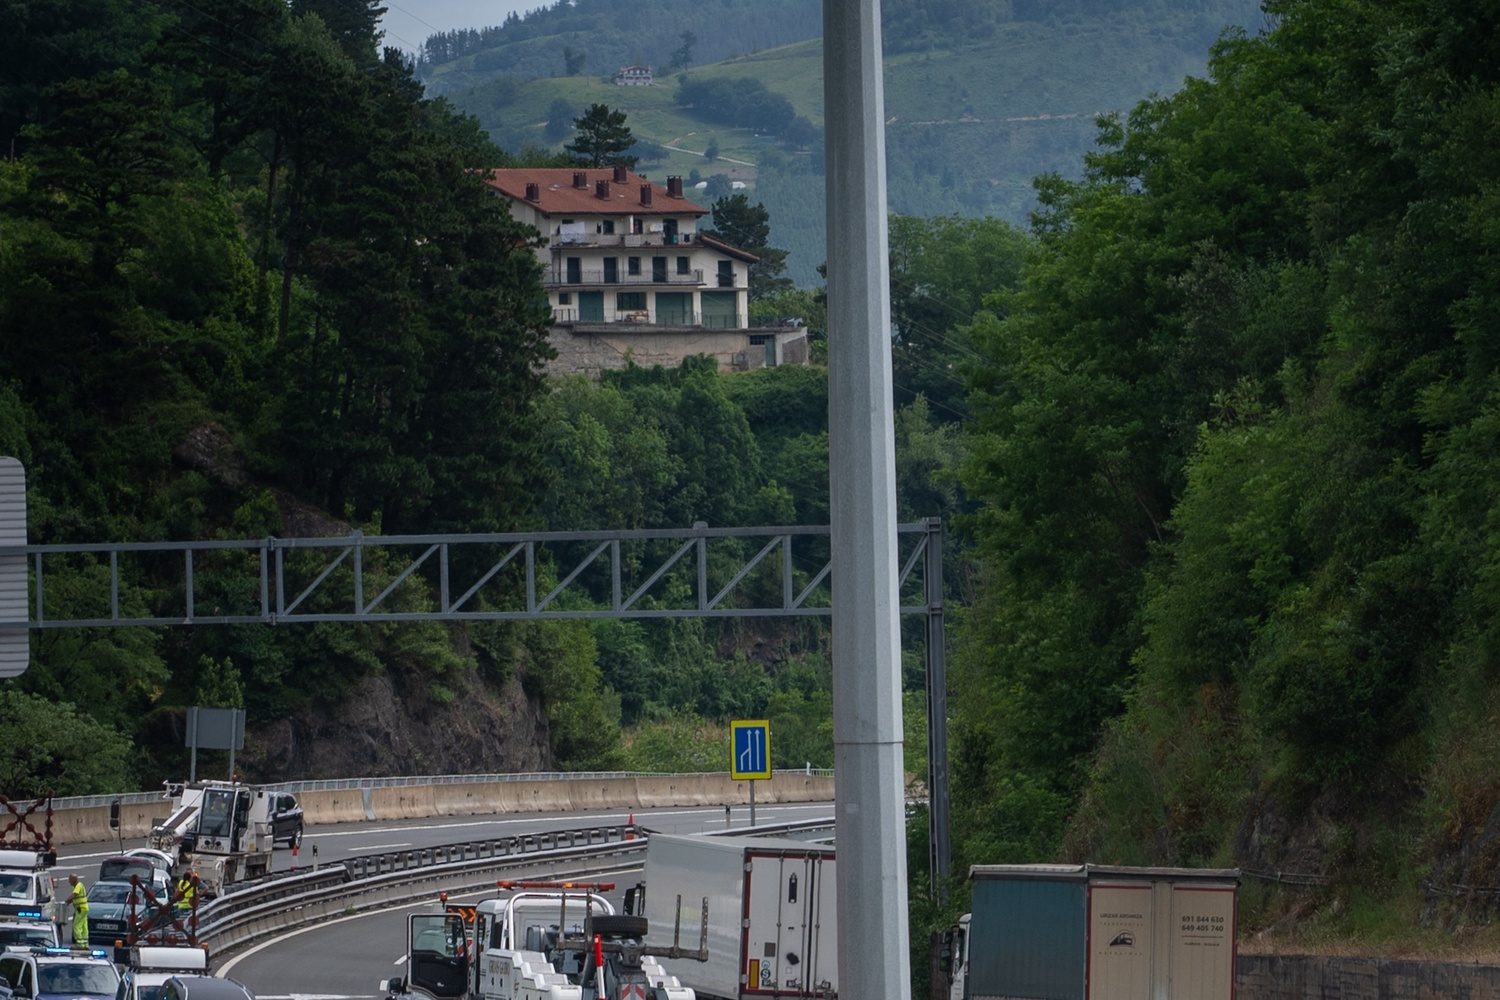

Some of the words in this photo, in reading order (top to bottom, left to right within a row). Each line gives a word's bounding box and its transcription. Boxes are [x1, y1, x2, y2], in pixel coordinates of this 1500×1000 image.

[1182, 915, 1195, 923] 691
[1196, 915, 1209, 923] 844
[1210, 915, 1224, 924] 630
[1181, 924, 1195, 932] 649
[1196, 924, 1209, 932] 405
[1210, 924, 1224, 932] 740
